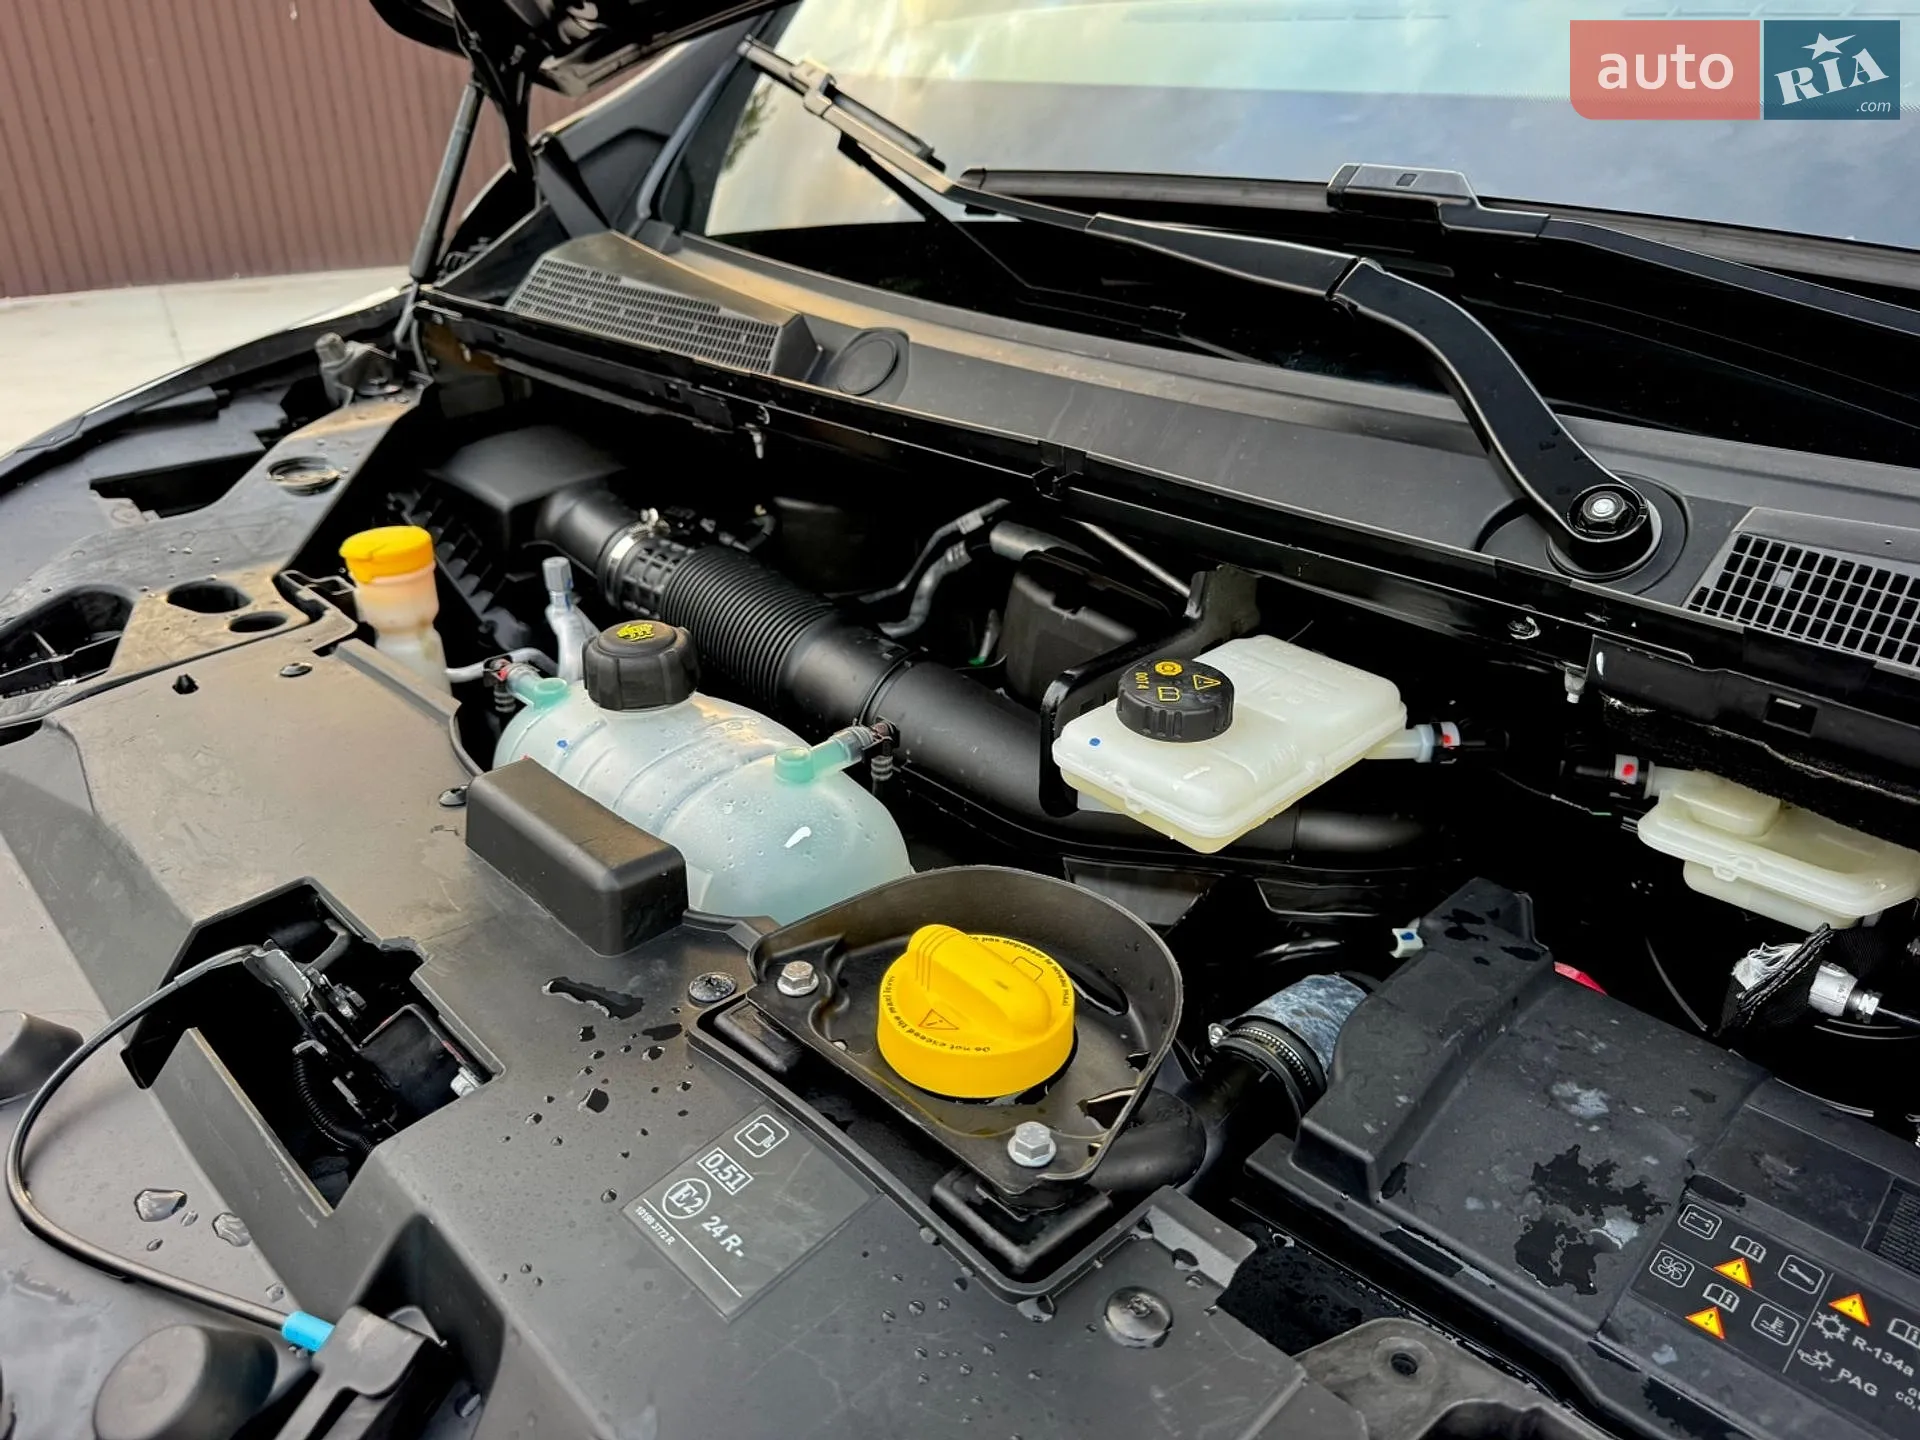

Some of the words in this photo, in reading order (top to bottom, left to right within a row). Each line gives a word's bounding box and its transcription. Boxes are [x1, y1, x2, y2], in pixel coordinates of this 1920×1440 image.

[894, 1015, 909, 1029] the
[906, 1028, 947, 1047] exceed
[949, 1043, 971, 1052] not
[667, 1181, 704, 1214] E2
[701, 1215, 729, 1238] 24
[1852, 1335, 1915, 1378] R-134a
[1837, 1367, 1879, 1397] PAG
